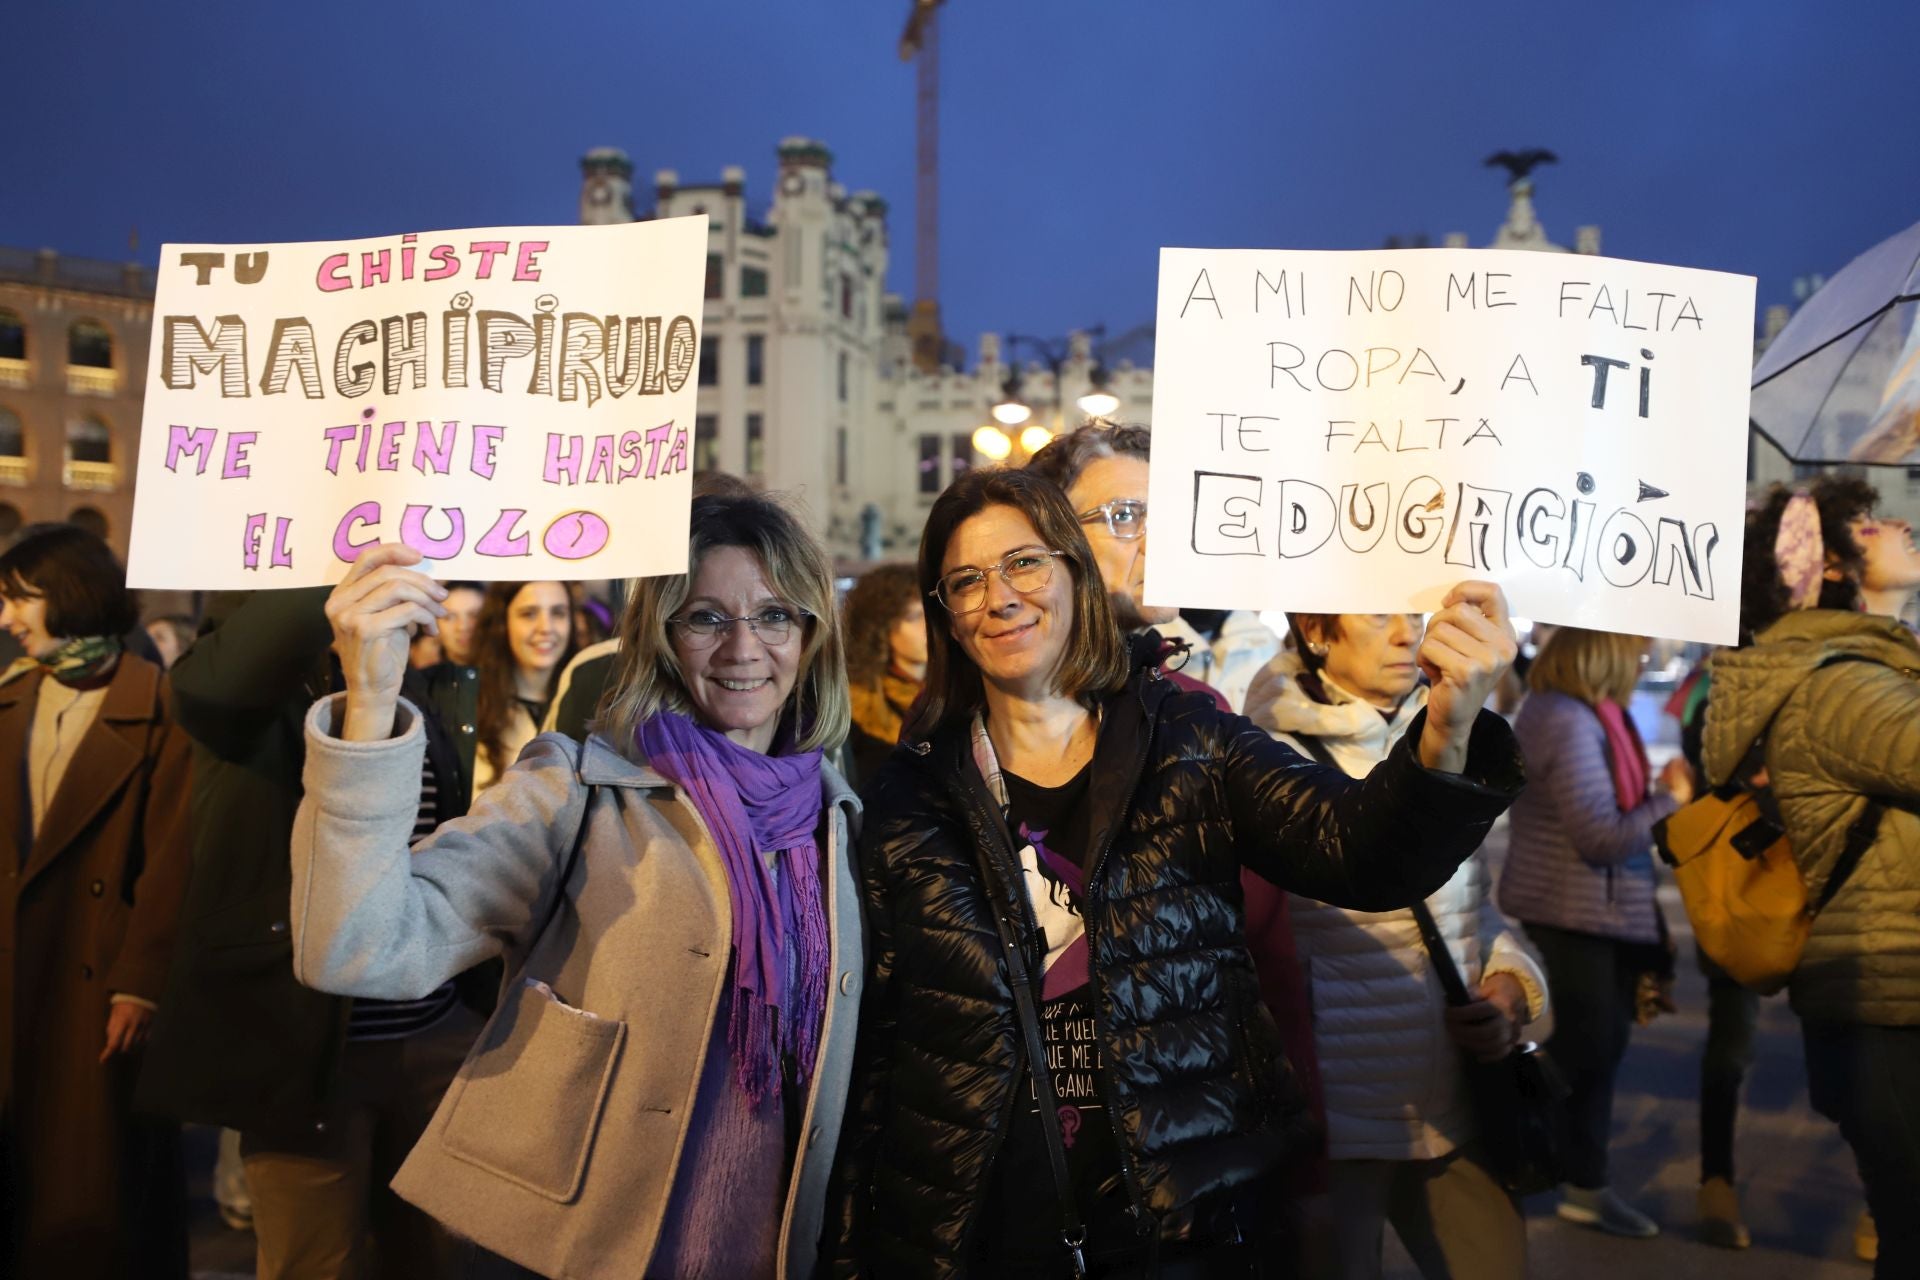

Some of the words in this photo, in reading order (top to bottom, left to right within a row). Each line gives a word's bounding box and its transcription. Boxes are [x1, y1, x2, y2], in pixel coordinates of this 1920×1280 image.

[180, 251, 269, 286] TU
[1180, 268, 1223, 319] A
[1255, 269, 1306, 319] MI
[1347, 269, 1405, 316] NO
[1446, 271, 1518, 313] ME
[1559, 281, 1704, 332] FALTA
[1267, 341, 1466, 395] ROPA,
[1500, 353, 1539, 396] A
[164, 425, 262, 480] ME
[542, 420, 689, 486] HASTA
[1206, 412, 1280, 452] TE
[1325, 418, 1503, 453] FALTA
[243, 512, 294, 571] EL
[332, 501, 610, 563] CULO
[1071, 1044, 1093, 1069] ME
[1055, 1073, 1098, 1098] GANA.
